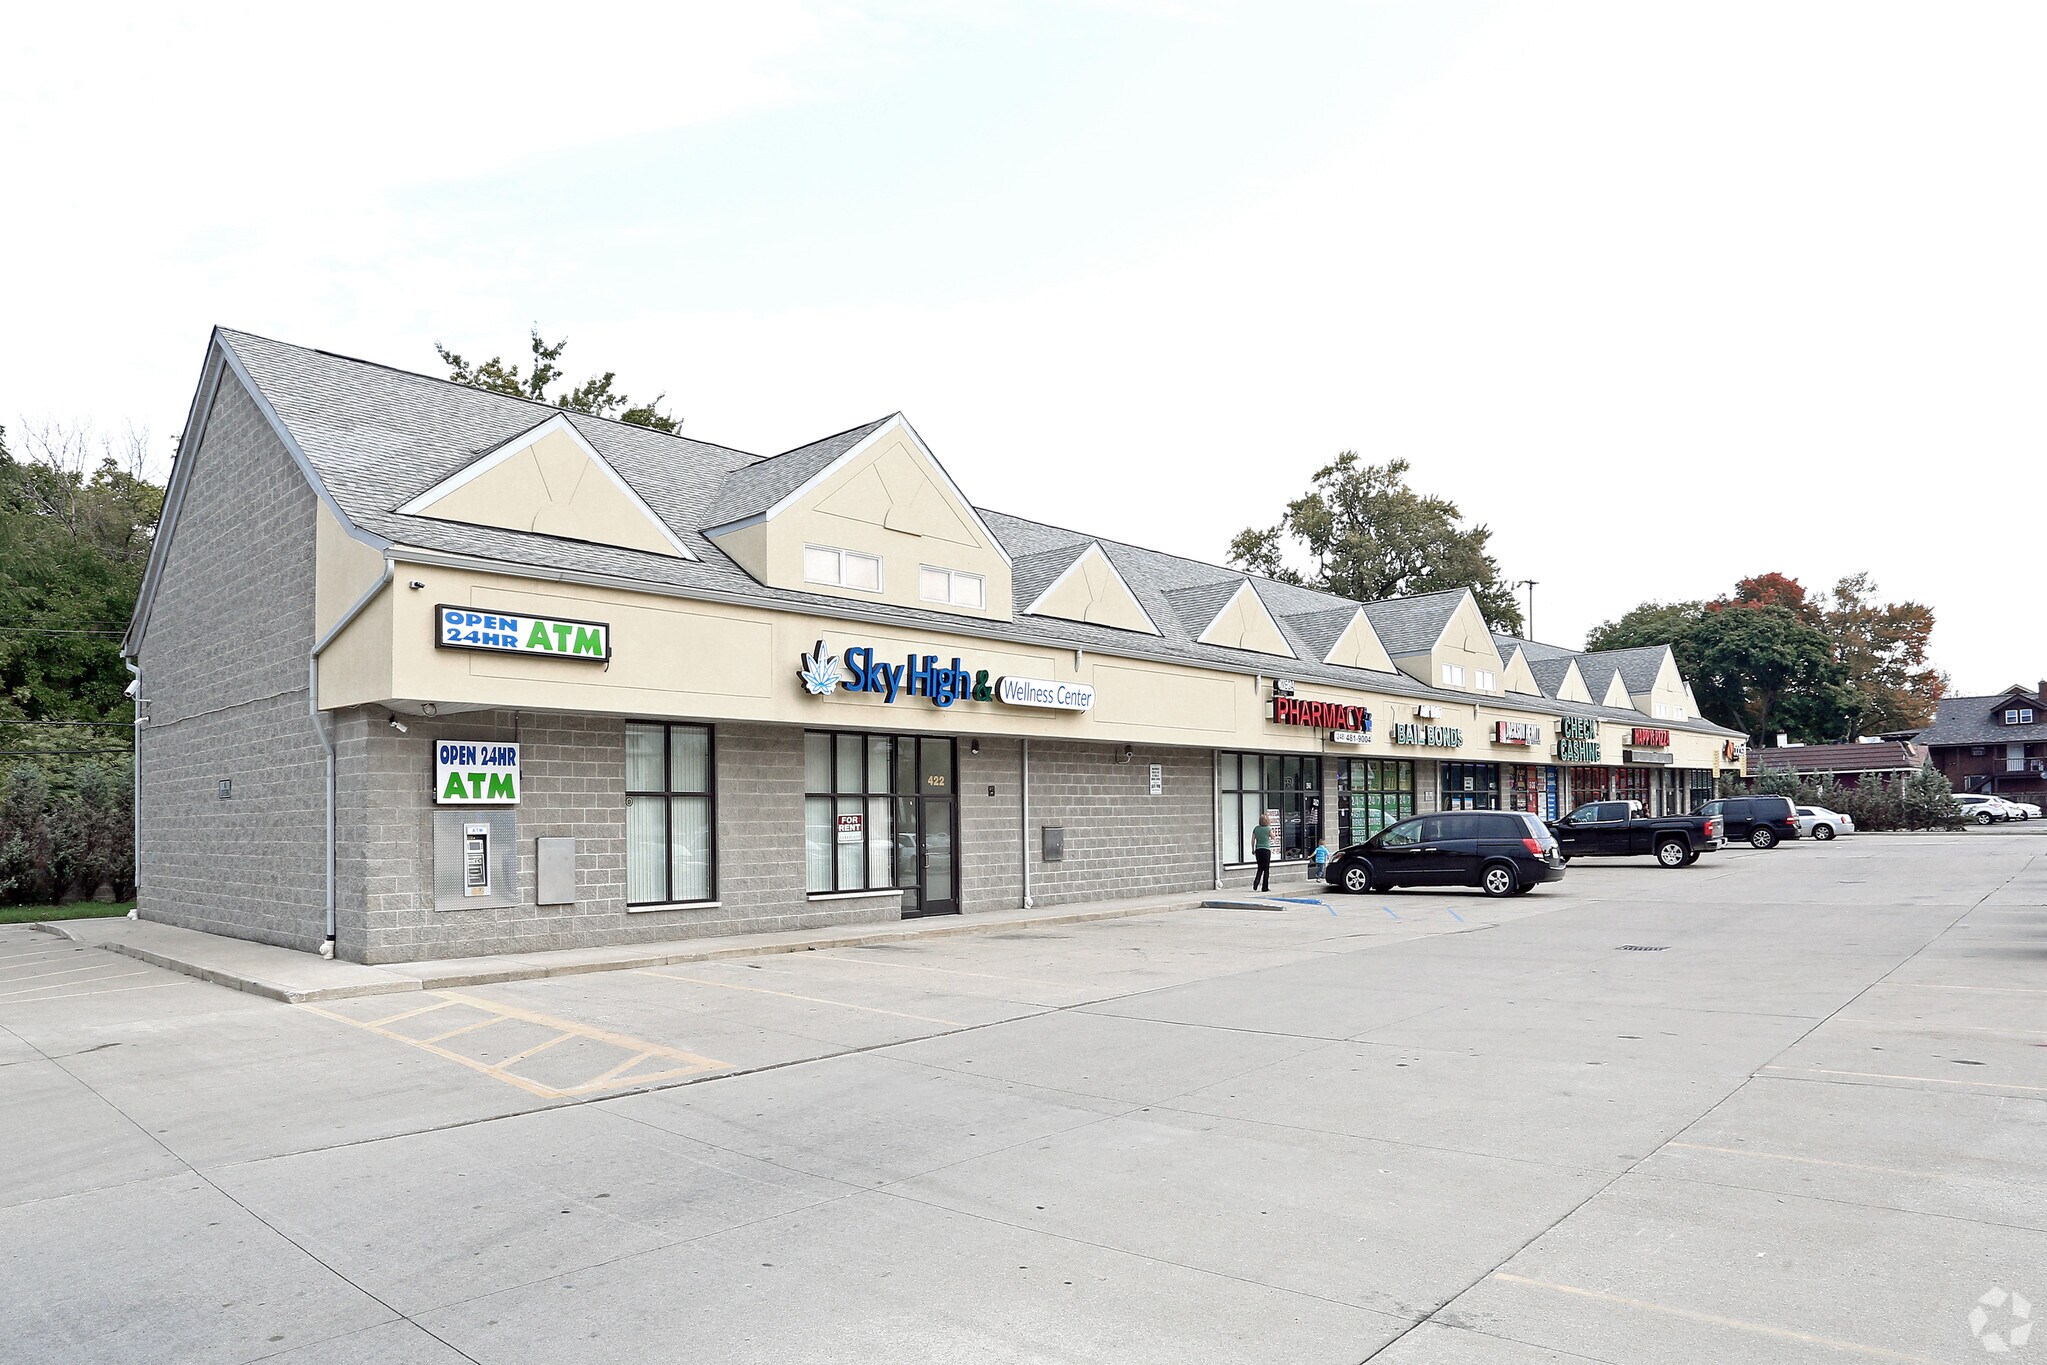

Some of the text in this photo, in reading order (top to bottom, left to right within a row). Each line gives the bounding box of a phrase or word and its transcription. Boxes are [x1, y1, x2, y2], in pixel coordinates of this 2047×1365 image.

[445, 611, 518, 632] OPEN
[447, 628, 518, 648] 24HR
[526, 621, 602, 656] ATM
[843, 647, 993, 707] Sky High &
[1004, 679, 1092, 708] Wellness Center
[1275, 697, 1364, 731] PHARMACY
[1396, 723, 1463, 748] BAIL BONDS
[1563, 715, 1596, 739] CHECK
[440, 745, 516, 766] OPEN 24HR
[1560, 739, 1601, 762] CASHING
[443, 771, 516, 799] ATM
[928, 775, 945, 786] 422
[838, 824, 861, 832] RENT
[841, 816, 858, 824] FOR
